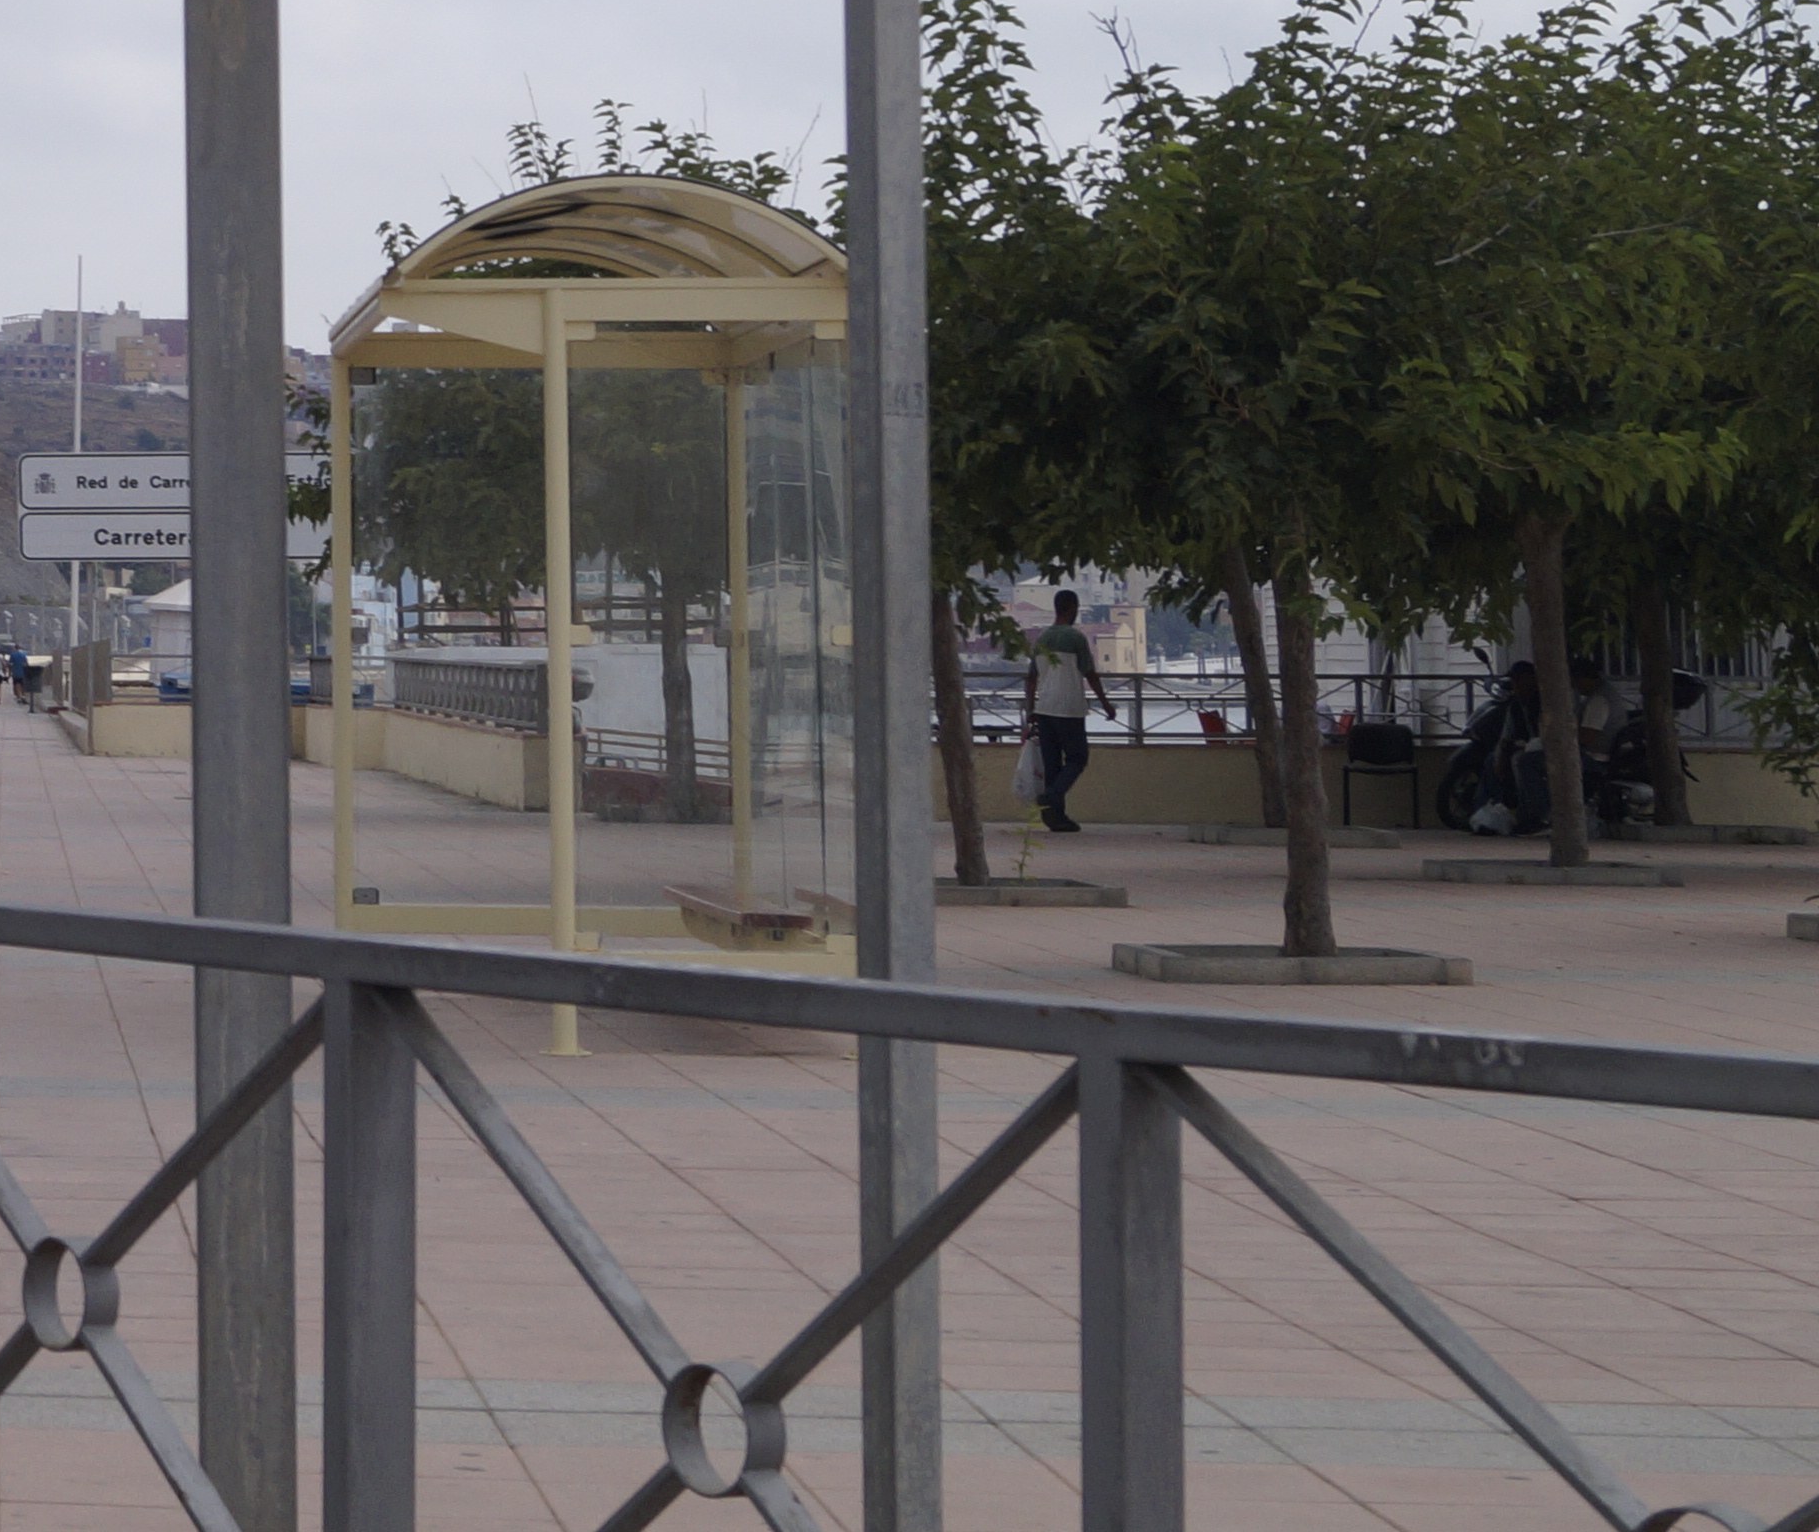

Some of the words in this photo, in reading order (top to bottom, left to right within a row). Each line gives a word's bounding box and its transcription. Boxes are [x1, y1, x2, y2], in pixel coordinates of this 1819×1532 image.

[76, 475, 108, 489] Red
[119, 475, 139, 489] de
[94, 528, 191, 546] Carreter
